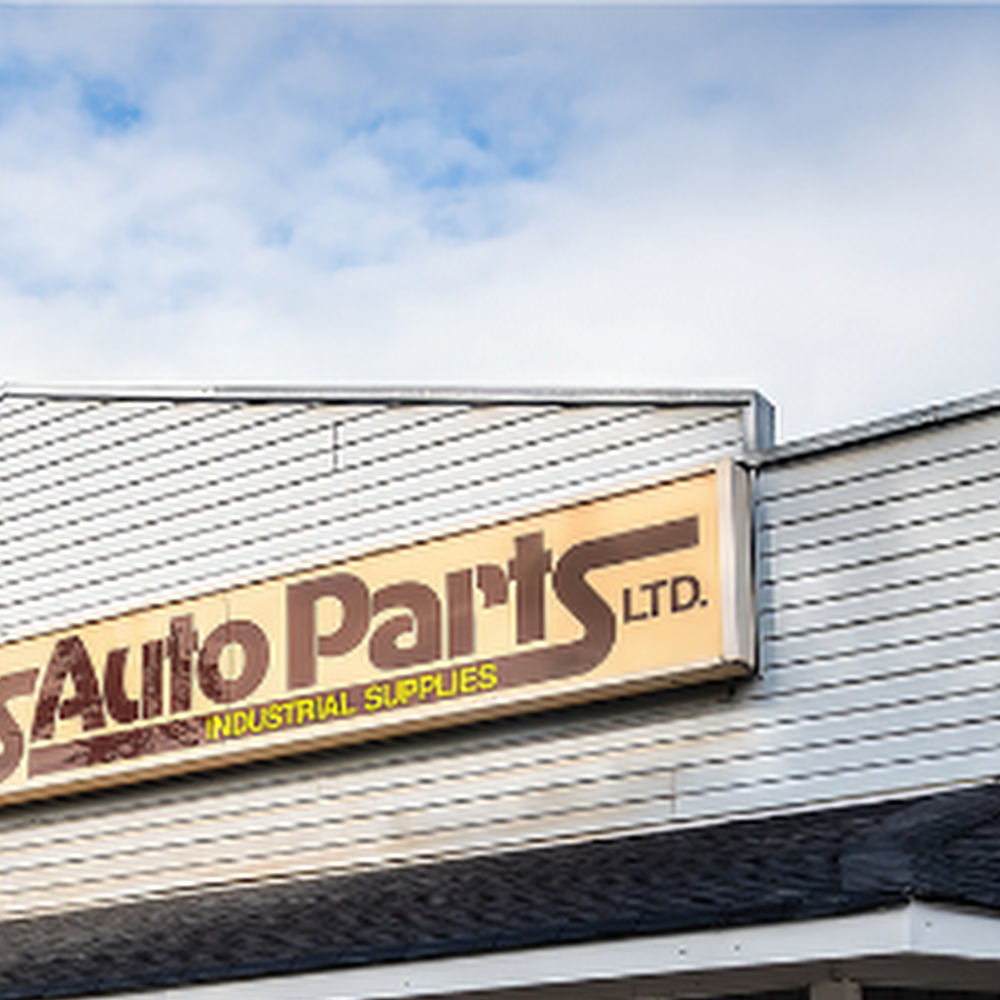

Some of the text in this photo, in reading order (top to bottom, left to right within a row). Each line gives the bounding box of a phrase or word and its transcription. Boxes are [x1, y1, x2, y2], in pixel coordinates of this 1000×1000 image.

[30, 612, 271, 743] Auto
[286, 515, 700, 691] Parts
[623, 574, 708, 624] LTD.
[205, 662, 499, 741] INDUSTRIAL SUPPLIES
